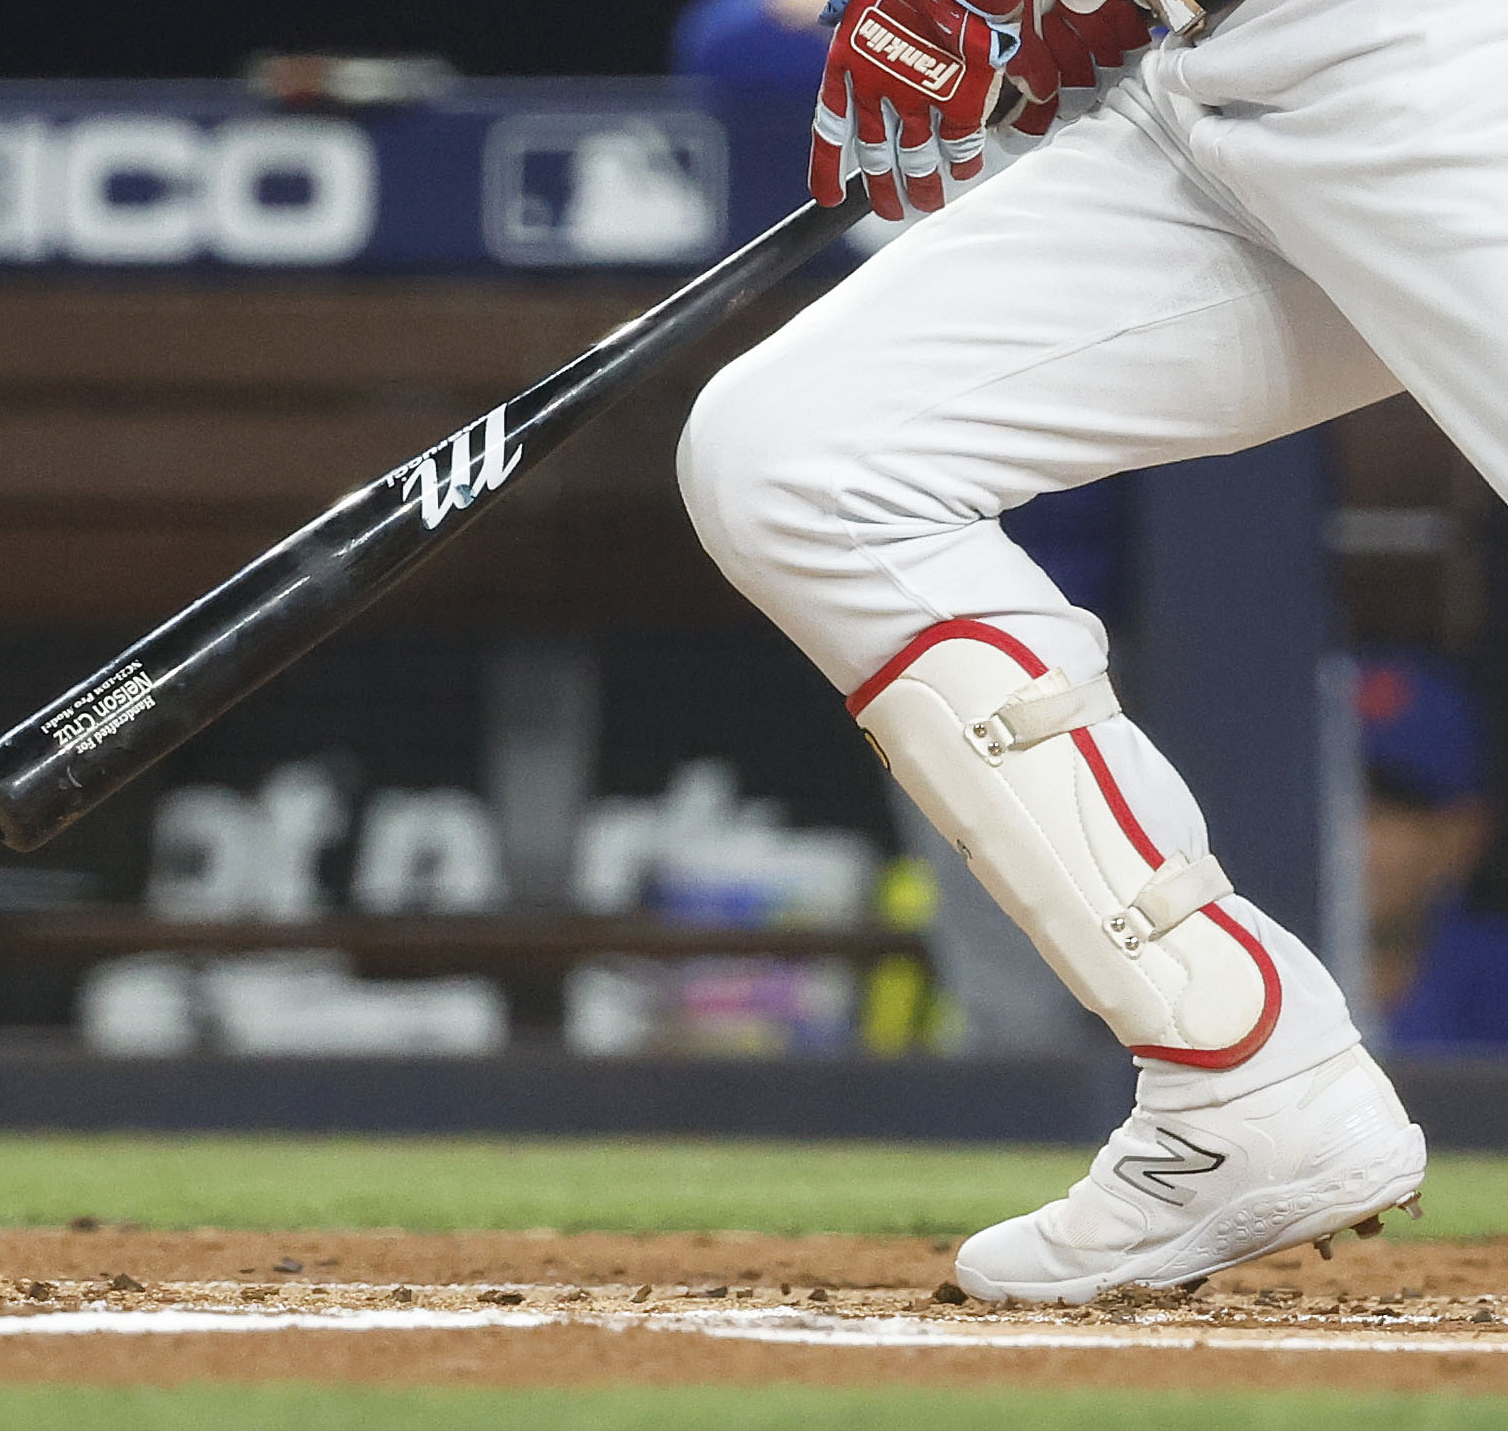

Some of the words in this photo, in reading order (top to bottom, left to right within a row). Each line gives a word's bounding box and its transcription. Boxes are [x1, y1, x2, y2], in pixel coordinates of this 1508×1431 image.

[858, 18, 961, 92] Franklin
[73, 692, 95, 709] Pro
[91, 671, 153, 717] Nelson
[40, 707, 75, 734] Model
[52, 712, 96, 746] Cruz
[93, 695, 156, 744] Handcrafted
[75, 737, 97, 754] For
